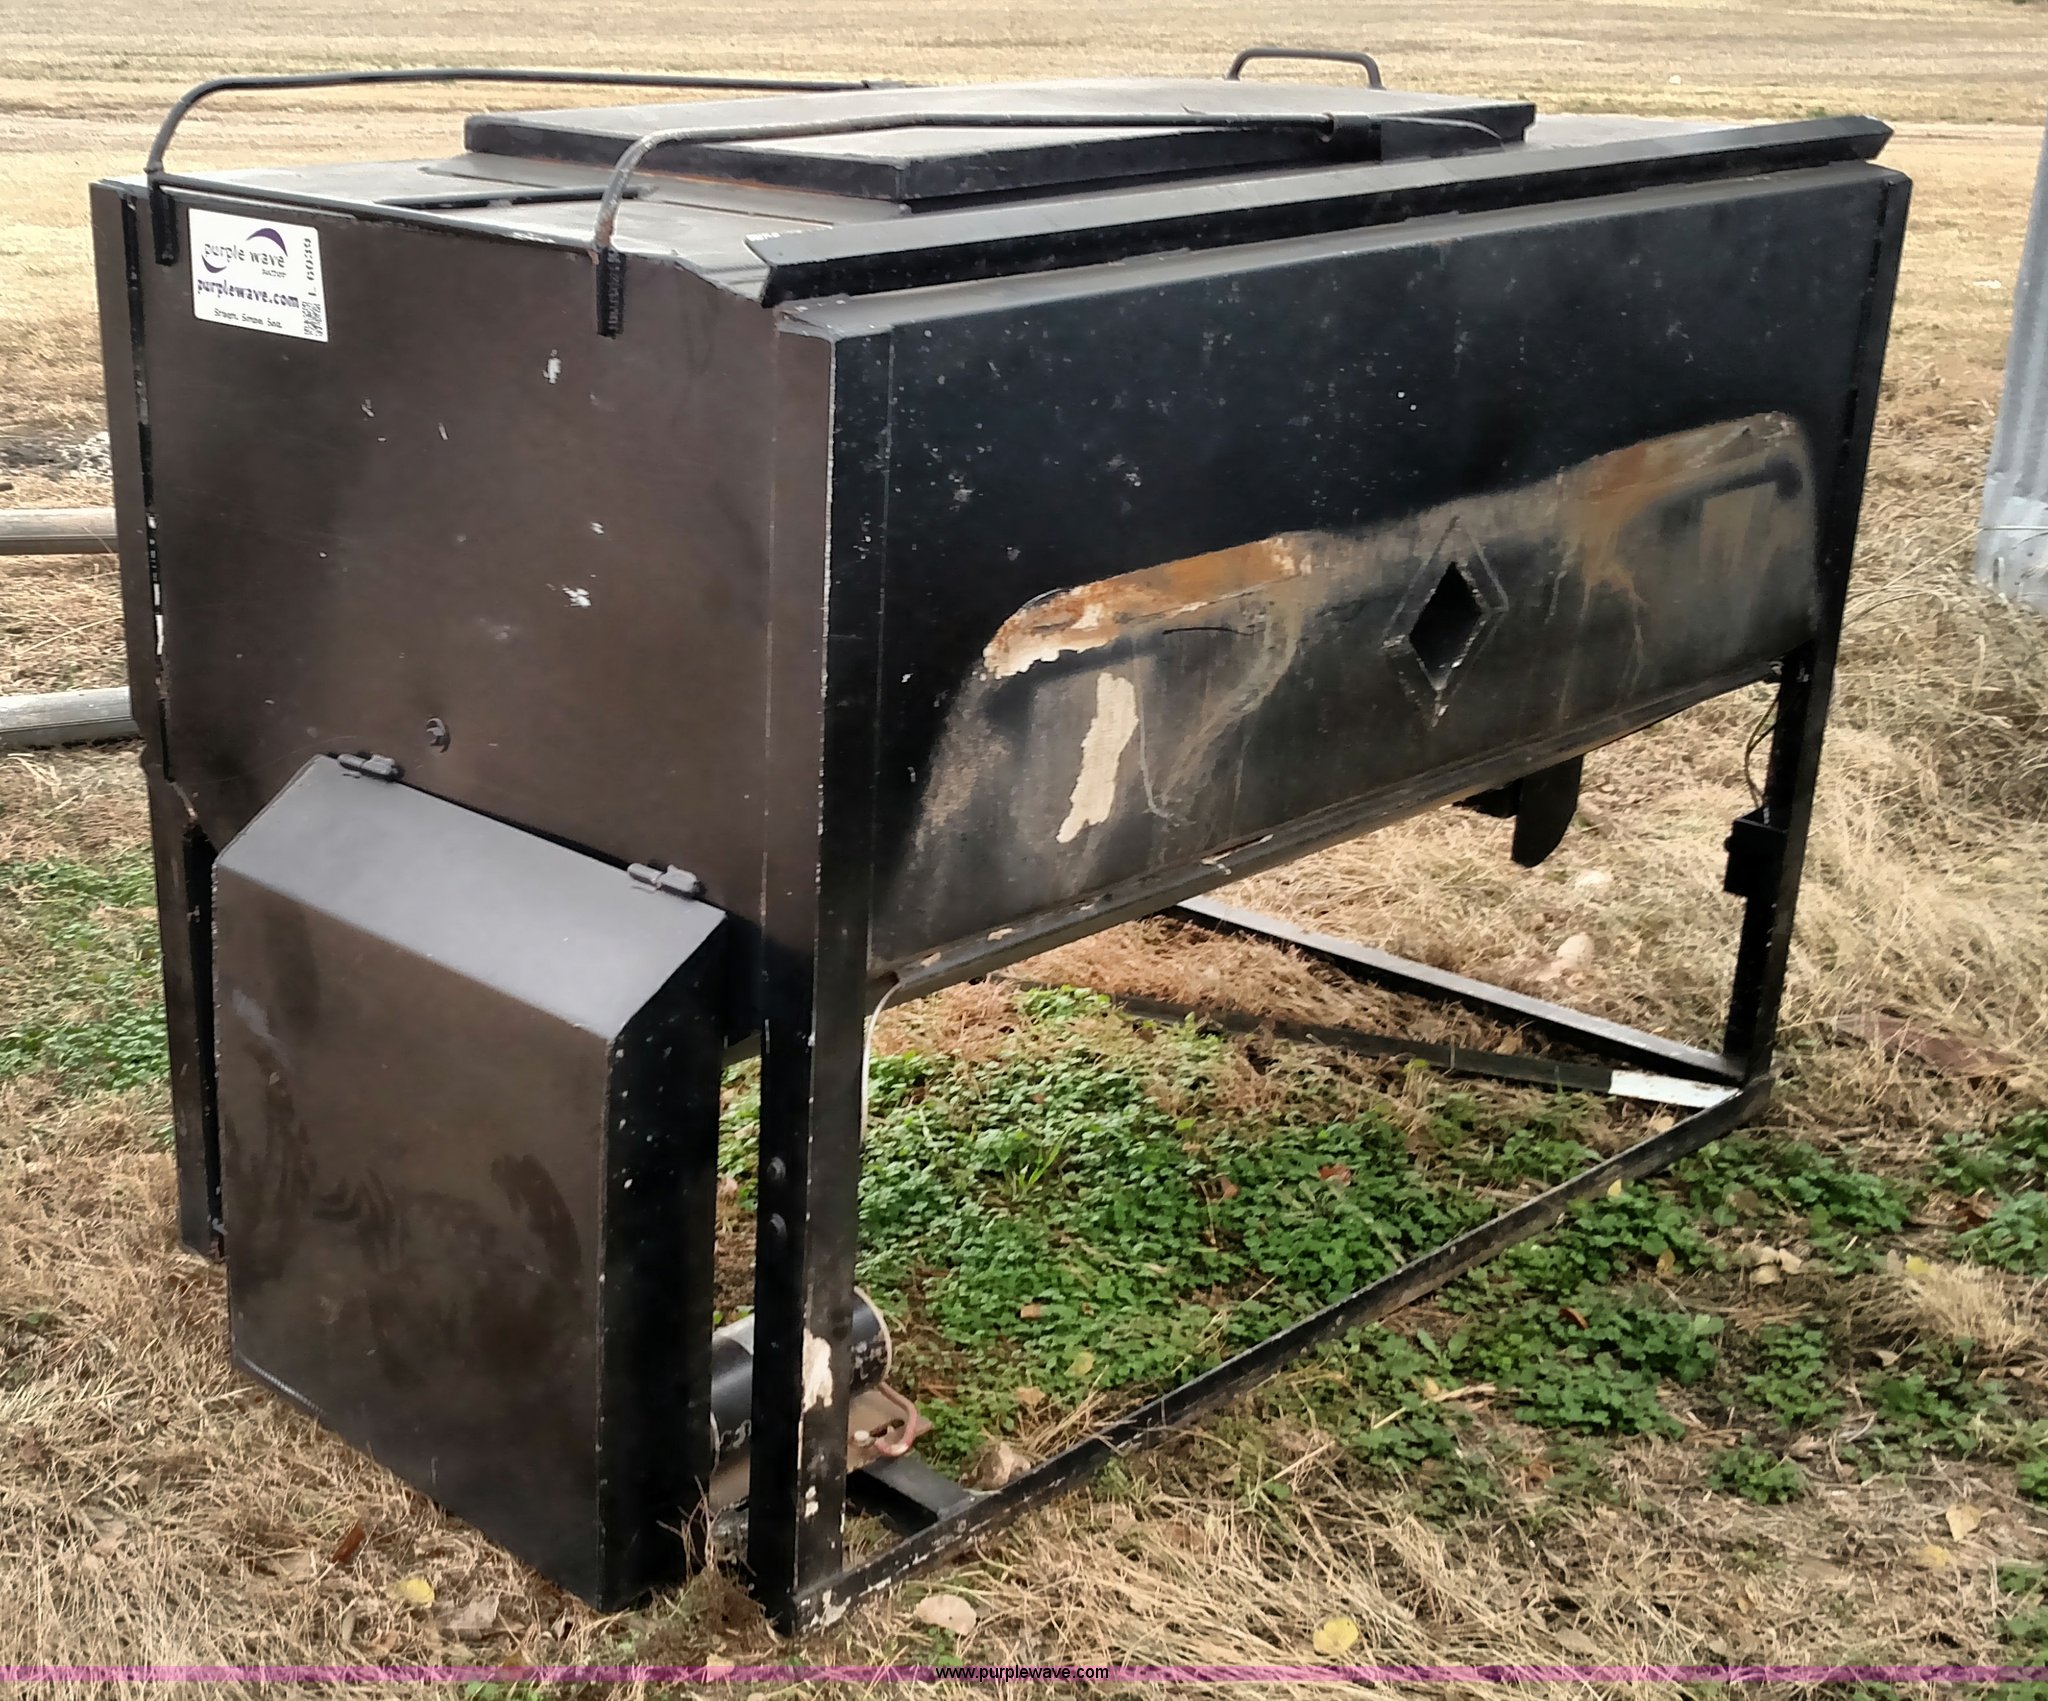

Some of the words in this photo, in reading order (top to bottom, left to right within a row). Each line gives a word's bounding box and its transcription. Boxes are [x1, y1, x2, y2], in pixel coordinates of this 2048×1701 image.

[204, 243, 245, 263] purple
[249, 251, 285, 268] wave
[197, 279, 300, 308] purplewave.com
